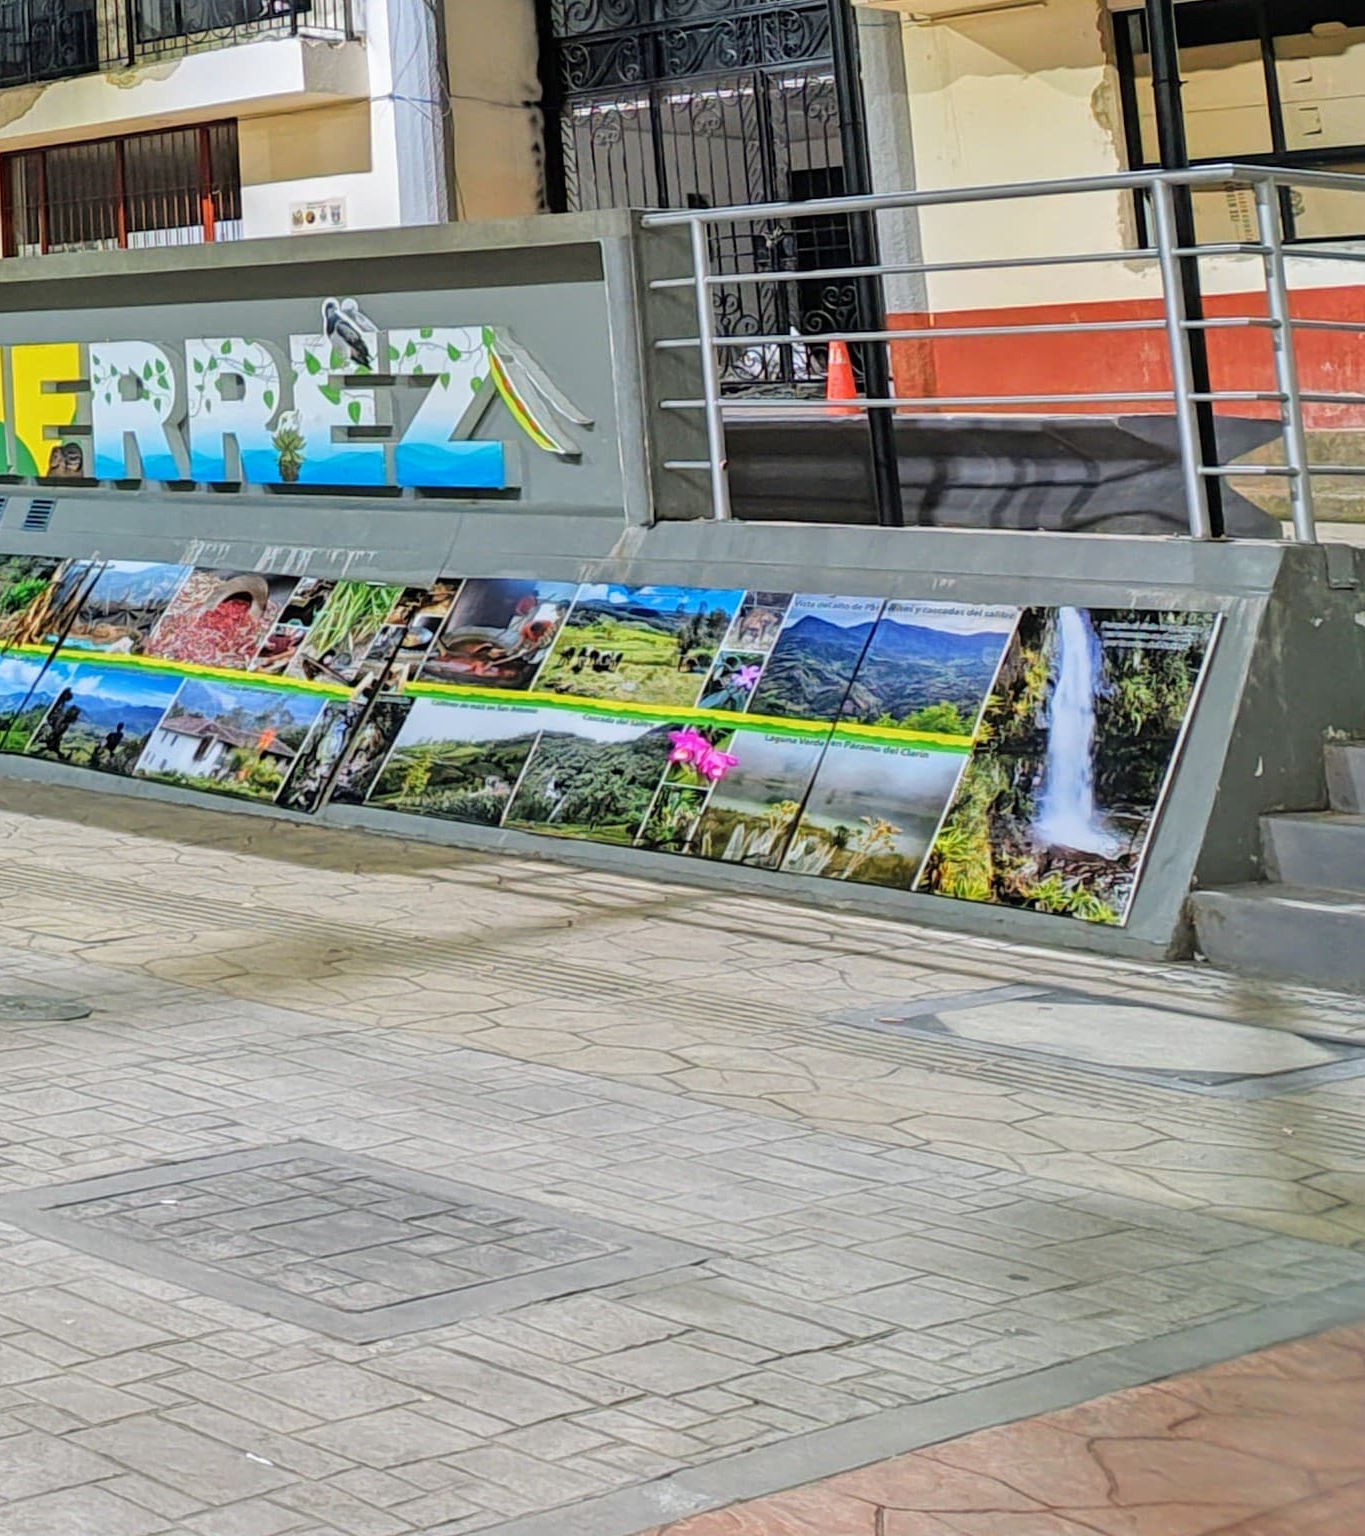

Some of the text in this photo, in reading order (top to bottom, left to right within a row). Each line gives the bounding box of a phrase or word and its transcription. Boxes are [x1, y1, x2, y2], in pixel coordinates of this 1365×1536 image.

[764, 734, 797, 745] Laguna
[799, 738, 824, 747] Verde
[883, 745, 899, 755] del
